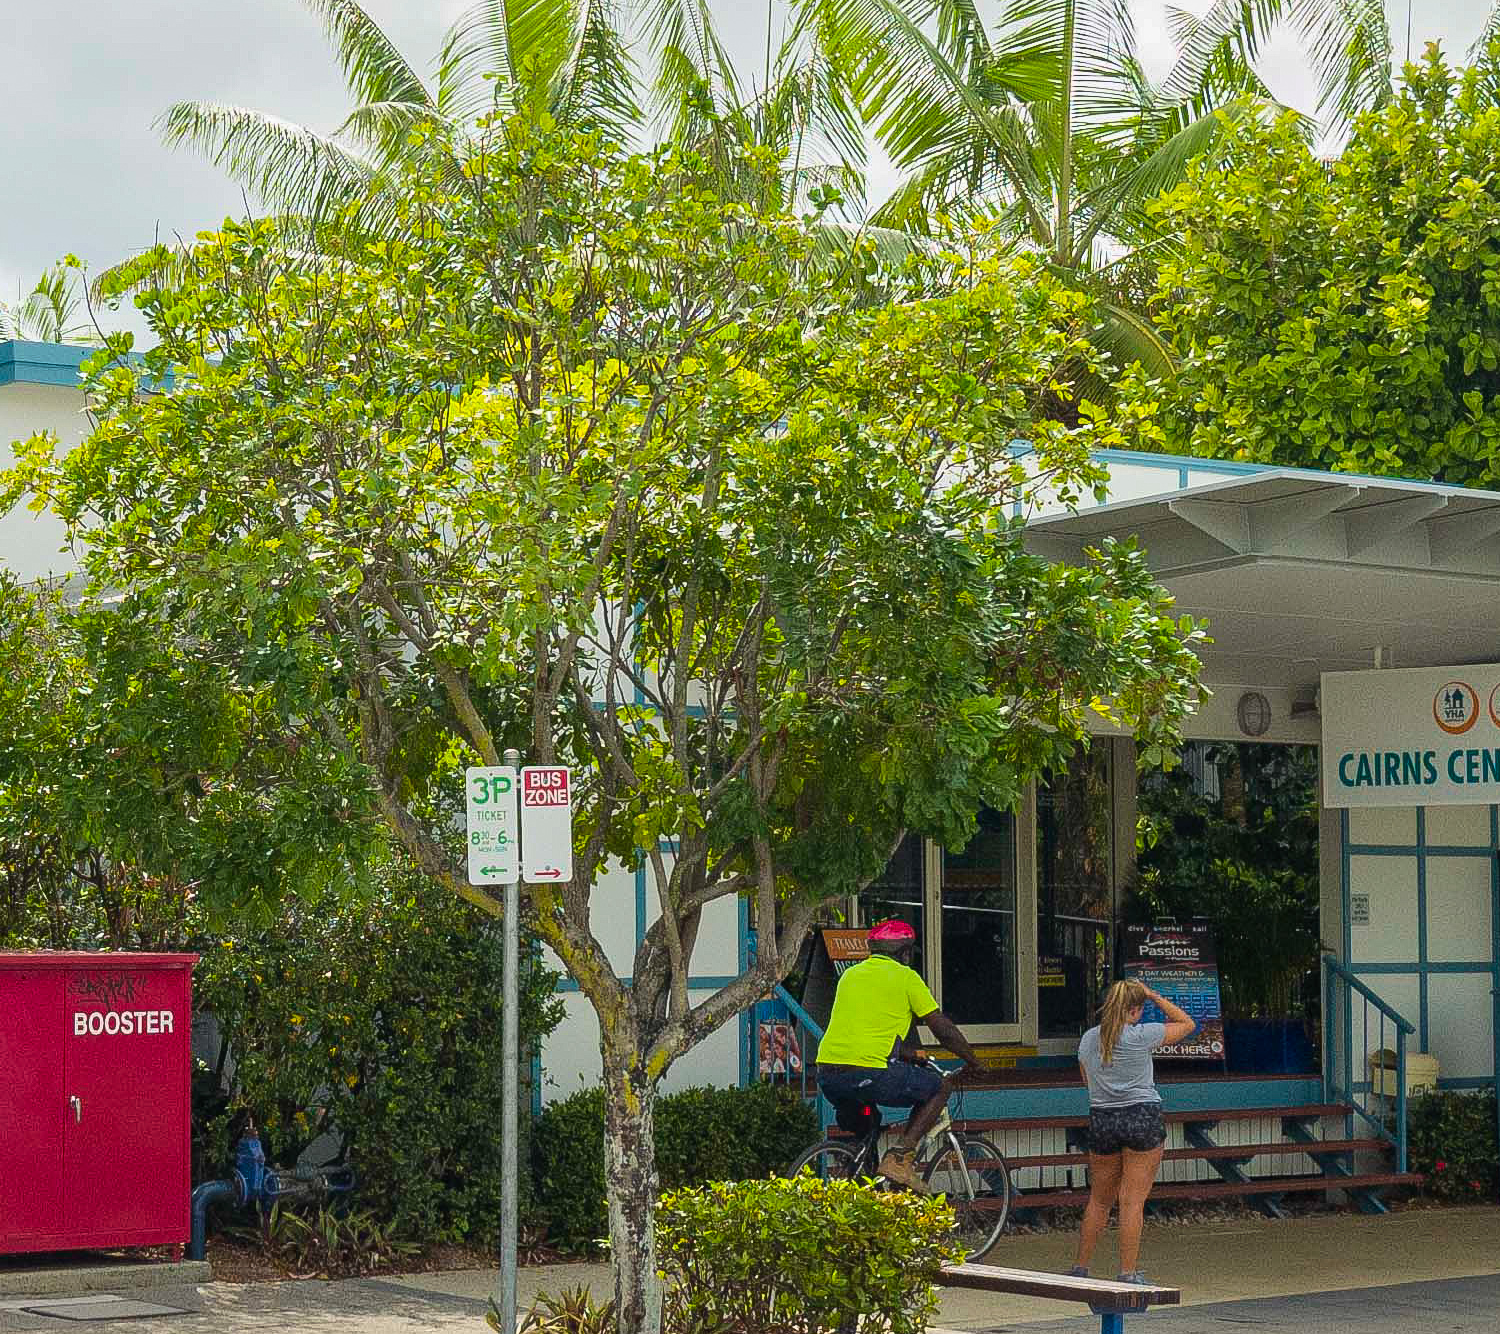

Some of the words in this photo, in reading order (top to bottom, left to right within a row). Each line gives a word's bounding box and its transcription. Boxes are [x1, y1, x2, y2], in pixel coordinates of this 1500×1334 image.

[1444, 709, 1465, 719] YHA
[1338, 751, 1438, 787] CAIRNS
[530, 771, 562, 787] BUS
[471, 776, 512, 804] 3P
[525, 788, 568, 804] ZONE
[477, 810, 507, 821] TICKET
[1138, 945, 1200, 956] Passions
[73, 1010, 174, 1036] BOOSTER
[1179, 1045, 1211, 1055] HERE
